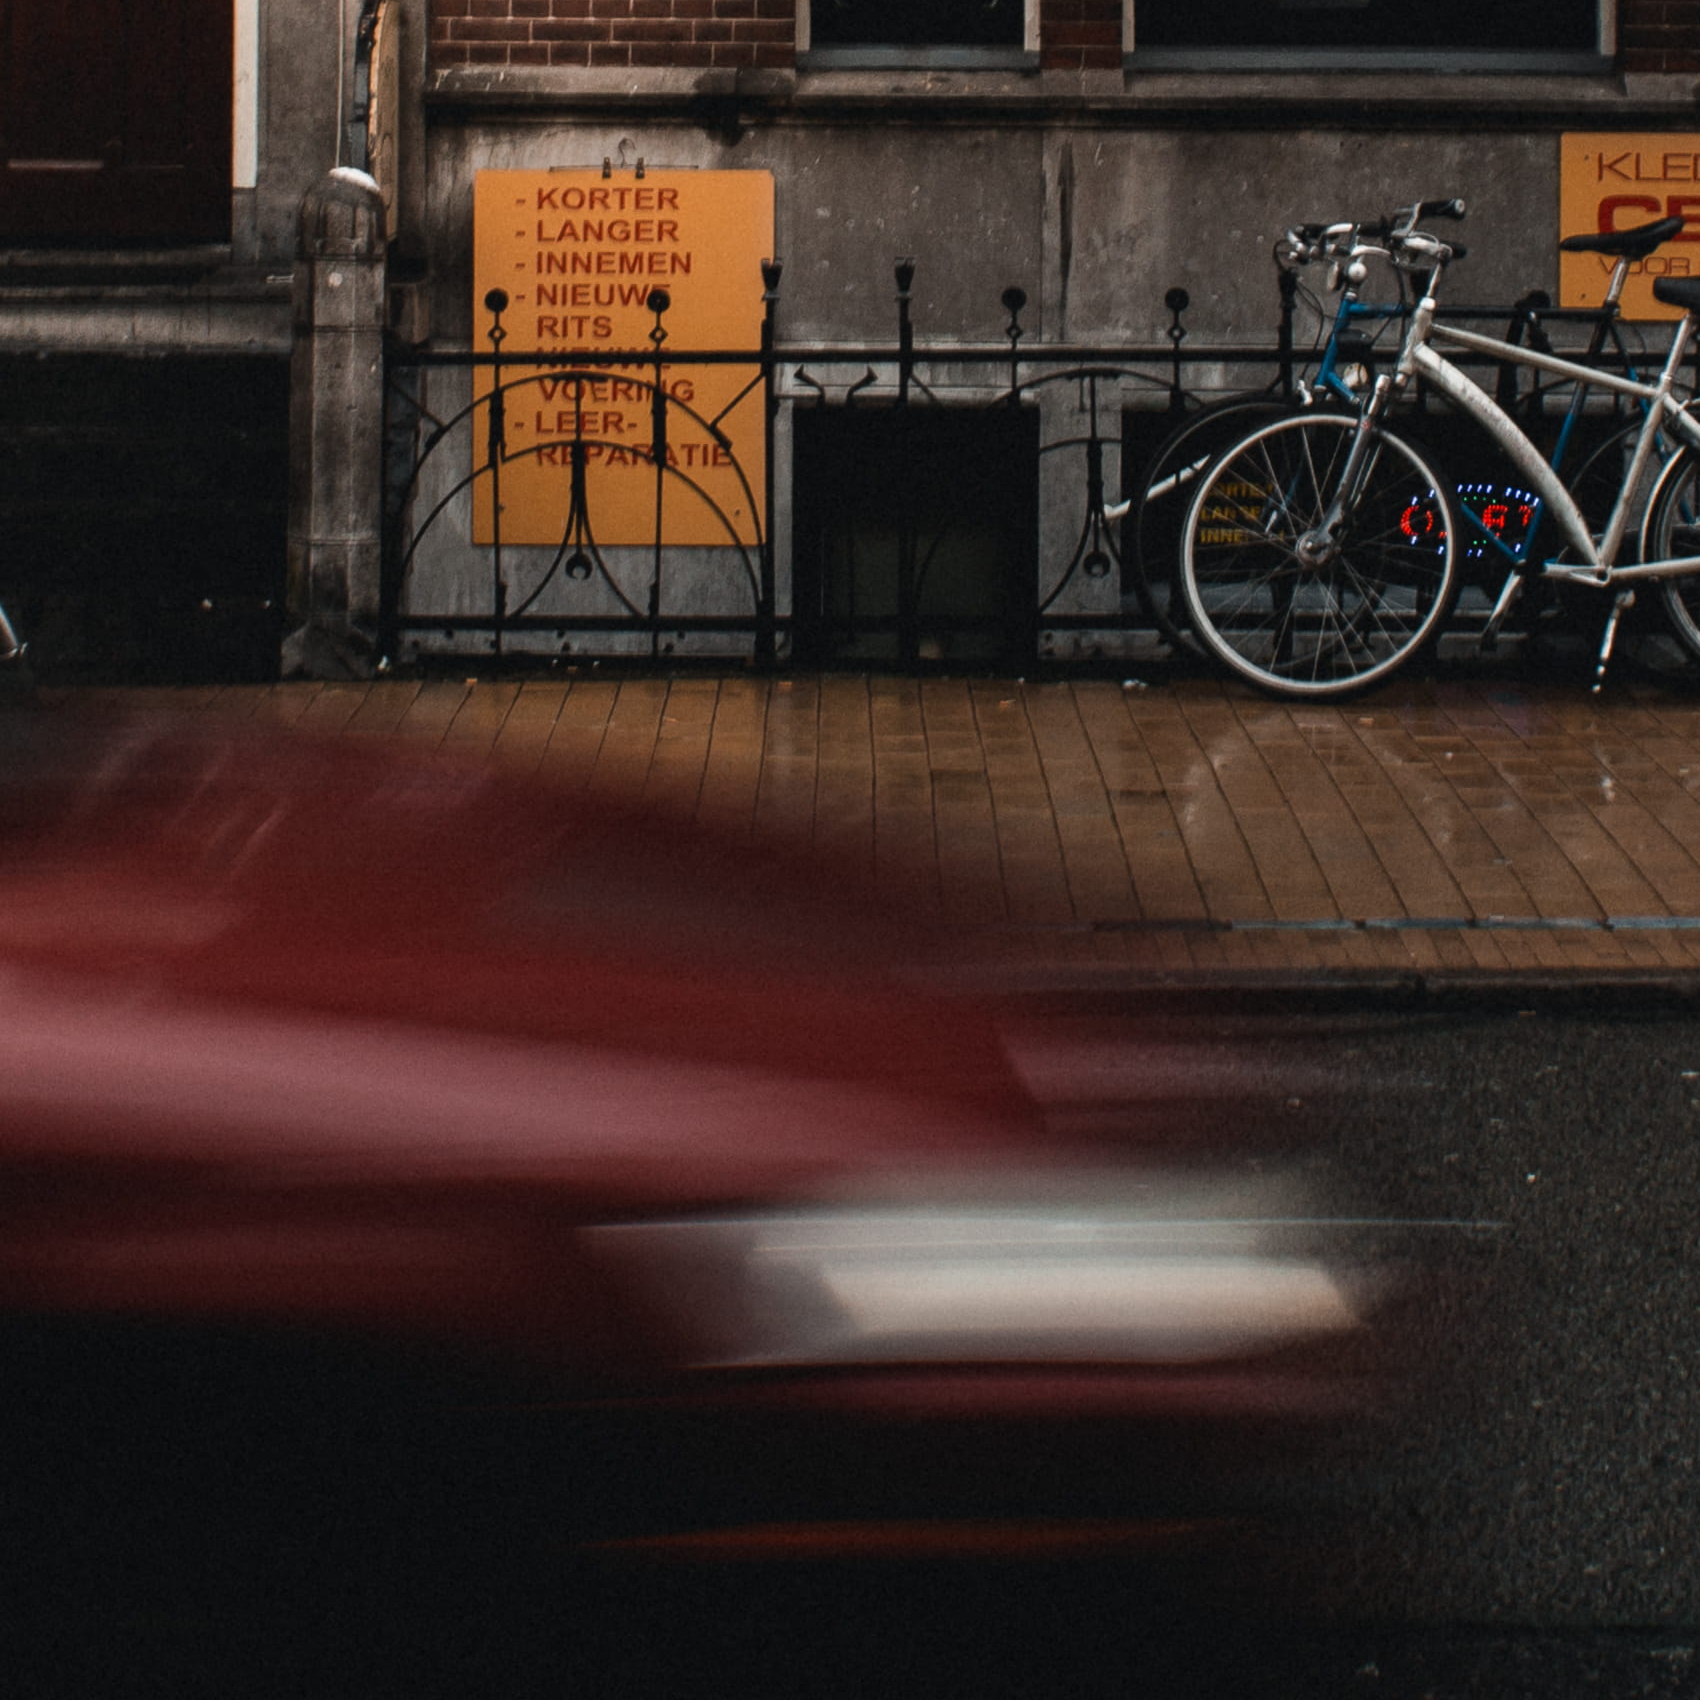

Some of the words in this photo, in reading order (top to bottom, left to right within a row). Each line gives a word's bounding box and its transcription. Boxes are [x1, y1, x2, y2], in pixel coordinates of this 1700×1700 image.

[536, 187, 680, 211] KORTER
[536, 219, 680, 243] LANGER
[536, 251, 693, 275] INNEMEN
[536, 283, 671, 307] NIEUW
[536, 315, 613, 339] RITS
